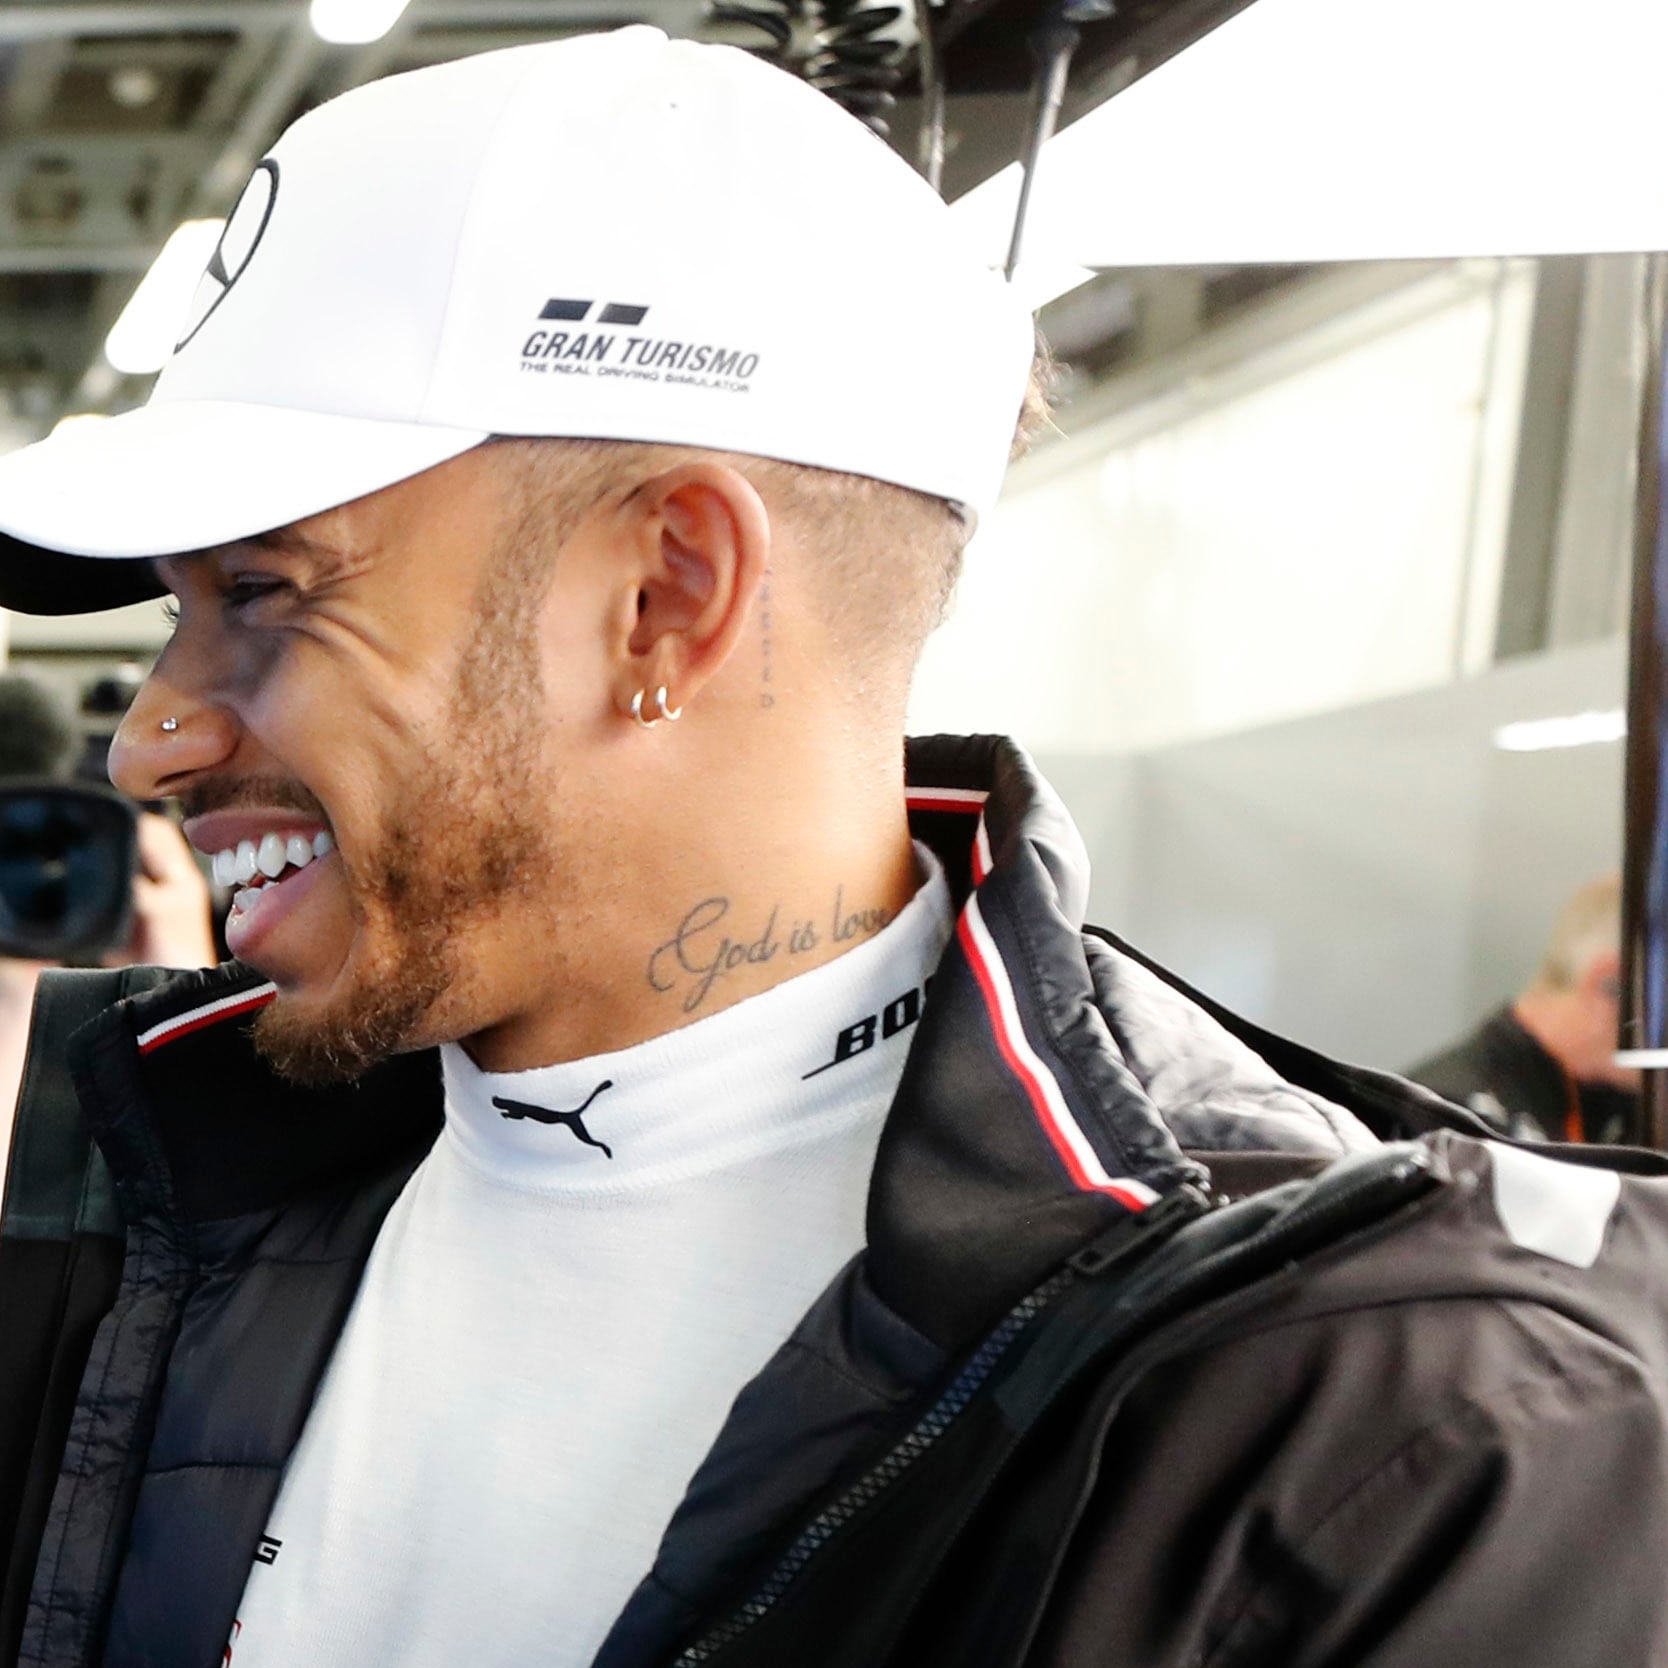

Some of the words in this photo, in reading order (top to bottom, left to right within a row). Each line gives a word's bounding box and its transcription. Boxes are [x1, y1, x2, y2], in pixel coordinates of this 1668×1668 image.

[520, 361, 548, 374] THE
[553, 362, 591, 376] REAL
[597, 366, 660, 382] DRIVING
[665, 373, 751, 394] SIMULATOR
[521, 331, 615, 362] GRAN
[620, 337, 760, 380] TURISMO
[648, 897, 779, 1013] God
[790, 919, 820, 954] is
[802, 975, 945, 1081] BO
